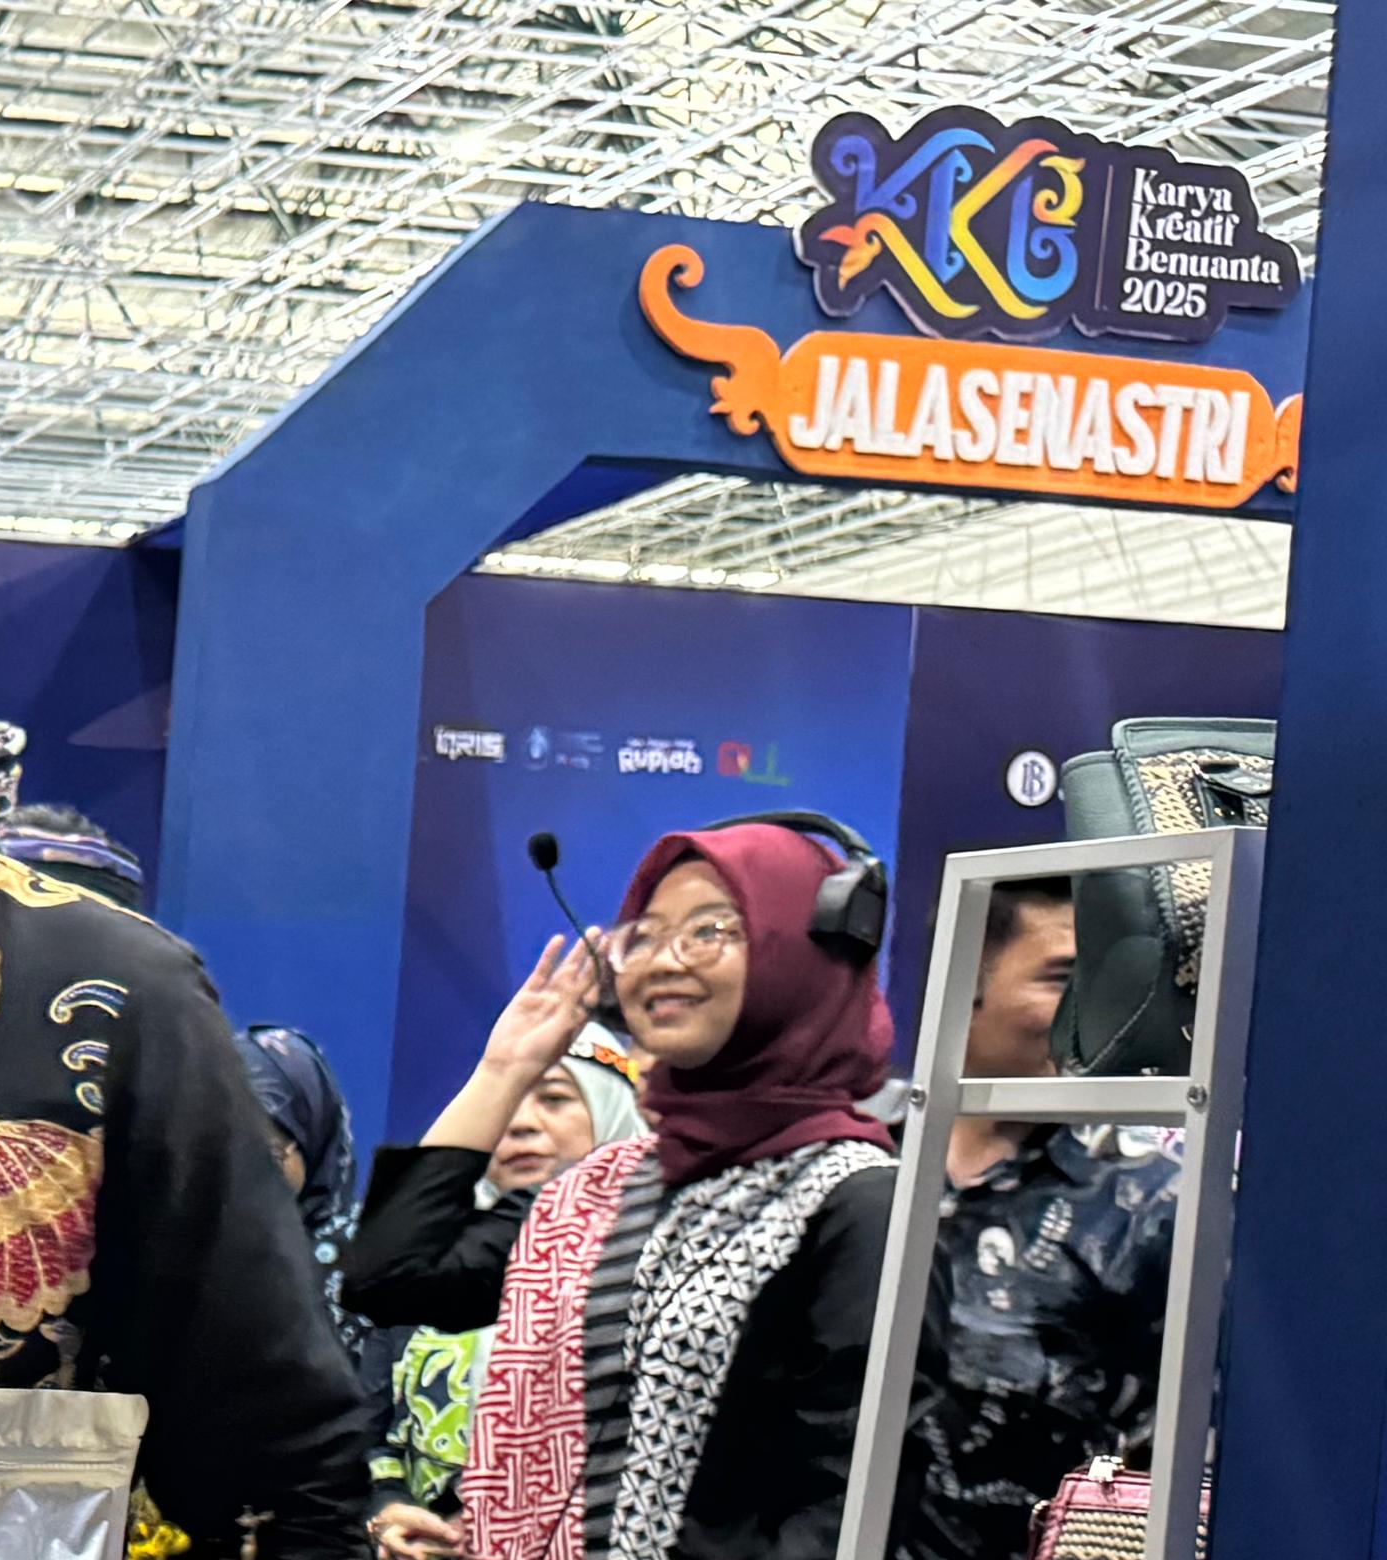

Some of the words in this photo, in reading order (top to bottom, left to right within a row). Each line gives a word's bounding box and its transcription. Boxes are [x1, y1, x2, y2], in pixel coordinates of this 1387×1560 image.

[1133, 168, 1233, 212] Karya
[1129, 203, 1241, 248] Kreatif
[1126, 237, 1281, 285] Benuanta
[1120, 277, 1208, 318] 2025
[789, 354, 1251, 486] JALASENASTRI
